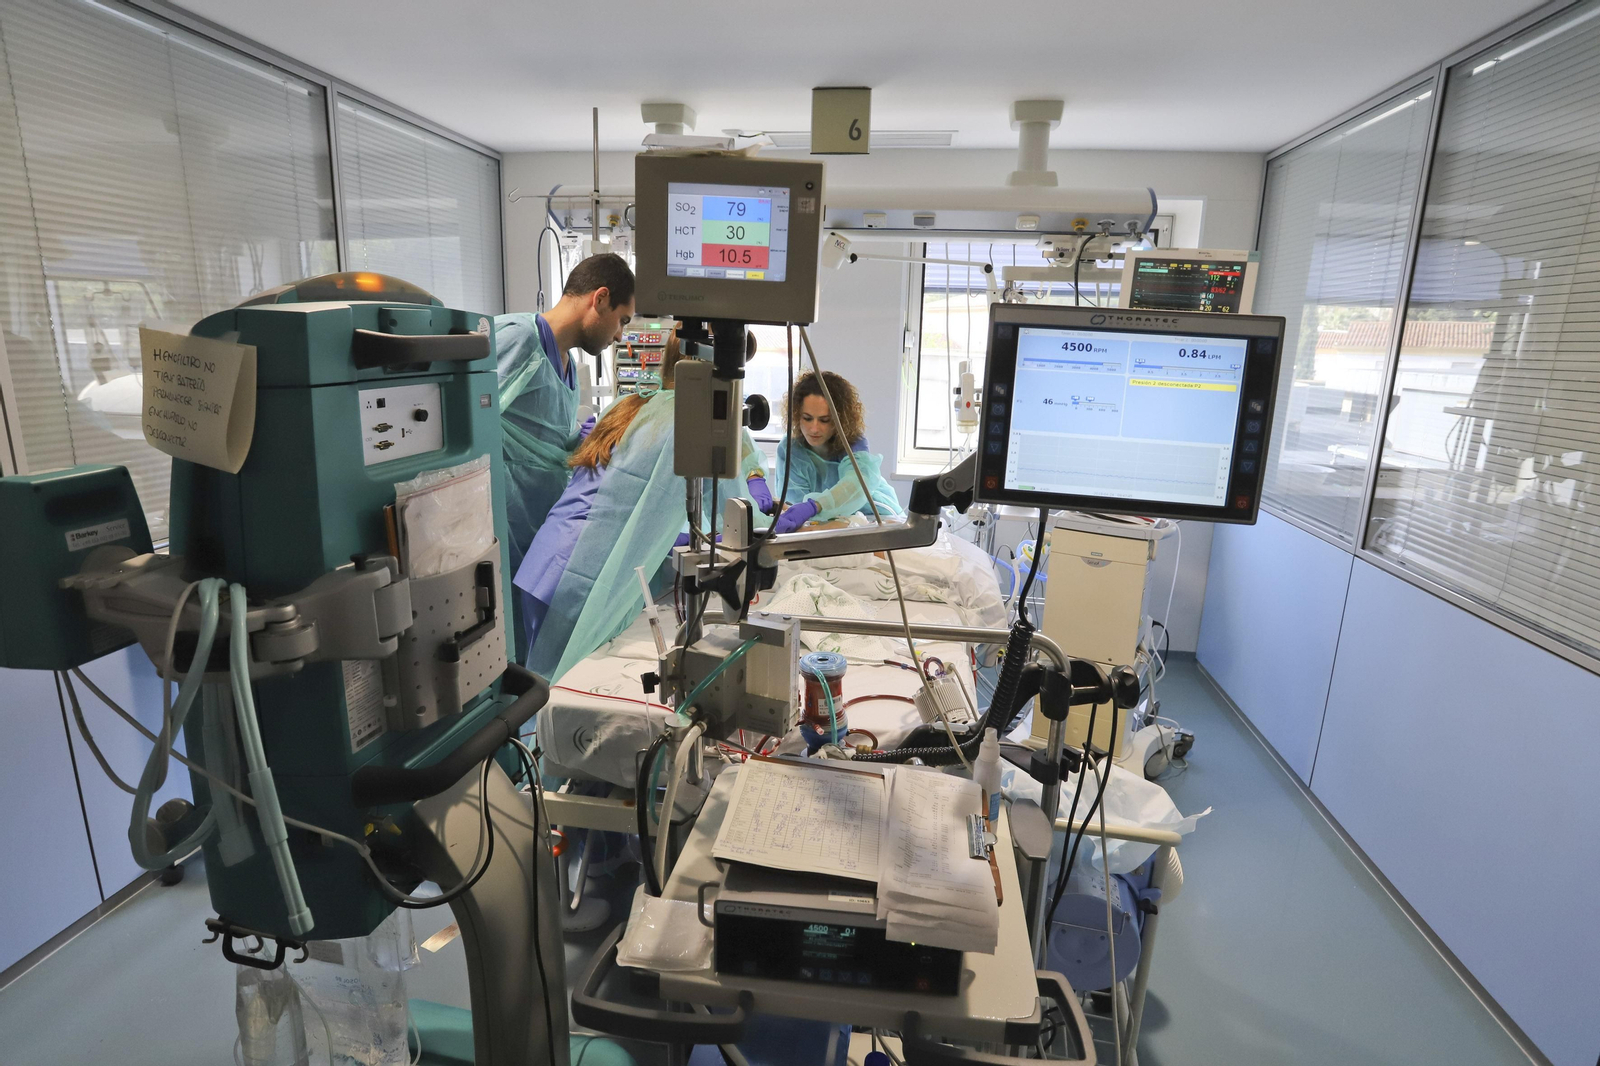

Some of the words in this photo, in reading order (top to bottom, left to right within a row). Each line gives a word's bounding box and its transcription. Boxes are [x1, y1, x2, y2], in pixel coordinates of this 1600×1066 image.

[848, 118, 862, 141] 6
[727, 202, 746, 216] 79
[674, 226, 696, 236] HCT
[726, 225, 746, 240] 30
[675, 250, 694, 260] Hgb
[719, 249, 752, 264] 10.5
[1062, 342, 1092, 352] 4500
[1179, 348, 1207, 359] 0.84
[204, 362, 216, 373] NO
[187, 420, 198, 431] NO
[75, 530, 98, 539] Barkey
